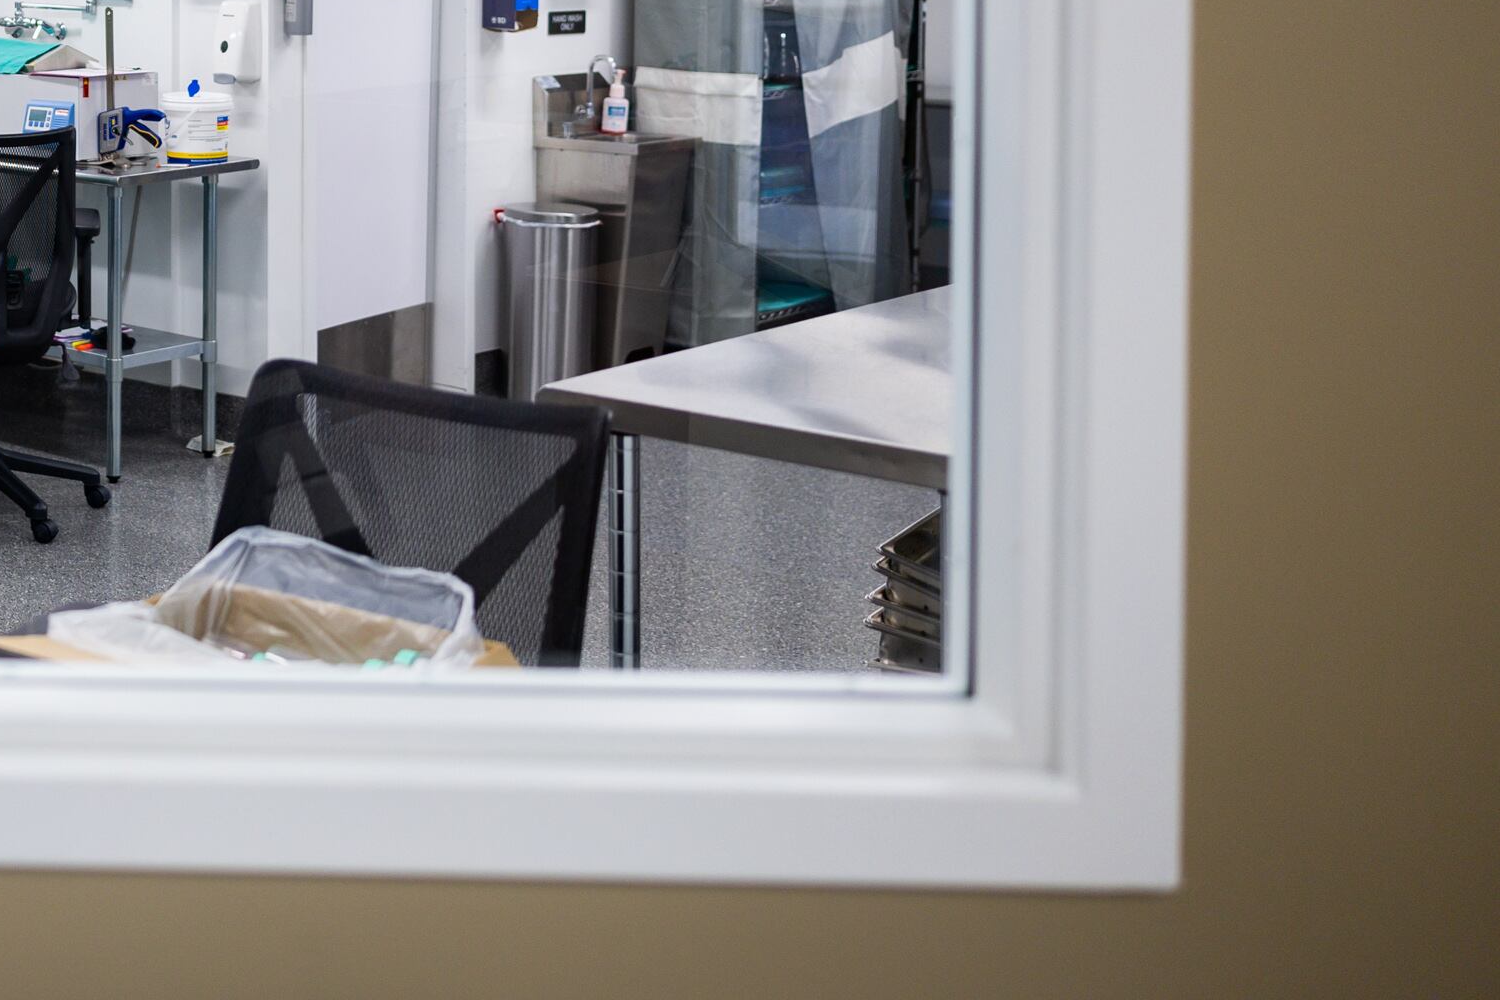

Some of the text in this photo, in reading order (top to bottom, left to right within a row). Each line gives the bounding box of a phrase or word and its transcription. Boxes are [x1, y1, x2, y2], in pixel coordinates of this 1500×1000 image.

[552, 14, 583, 23] HAND WASH
[560, 22, 575, 31] ONLY
